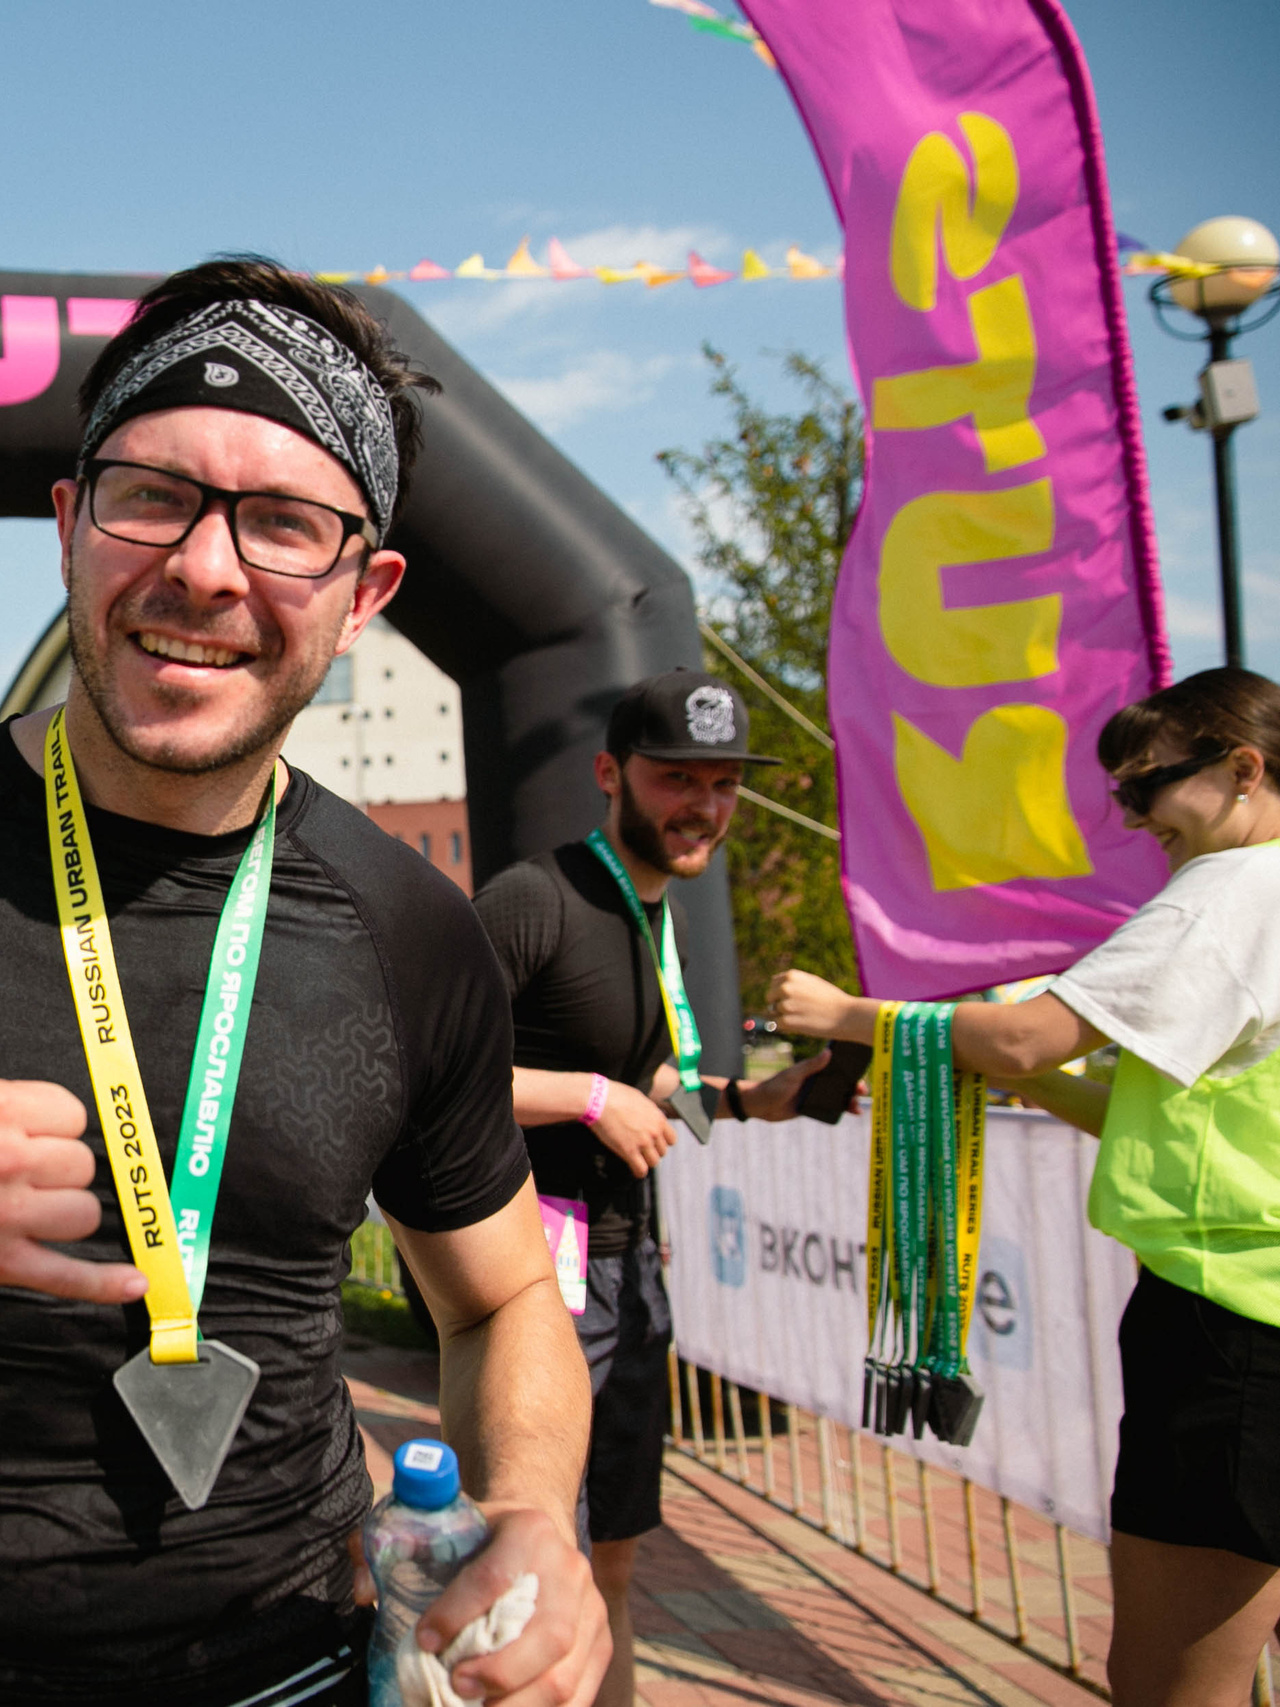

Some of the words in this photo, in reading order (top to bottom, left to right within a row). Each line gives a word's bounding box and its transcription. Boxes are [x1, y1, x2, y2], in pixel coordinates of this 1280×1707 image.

[51, 729, 69, 809] TRAIL
[58, 810, 89, 909] URBAN
[73, 914, 117, 1045] RUSSIAN
[226, 923, 251, 967] ПО
[187, 971, 242, 1178] ЯРОСЛАВЛЮ
[972, 1086, 983, 1138] URBAN
[110, 1085, 144, 1157] 2023
[129, 1165, 164, 1250] RUTS
[966, 1184, 979, 1235] SERIES
